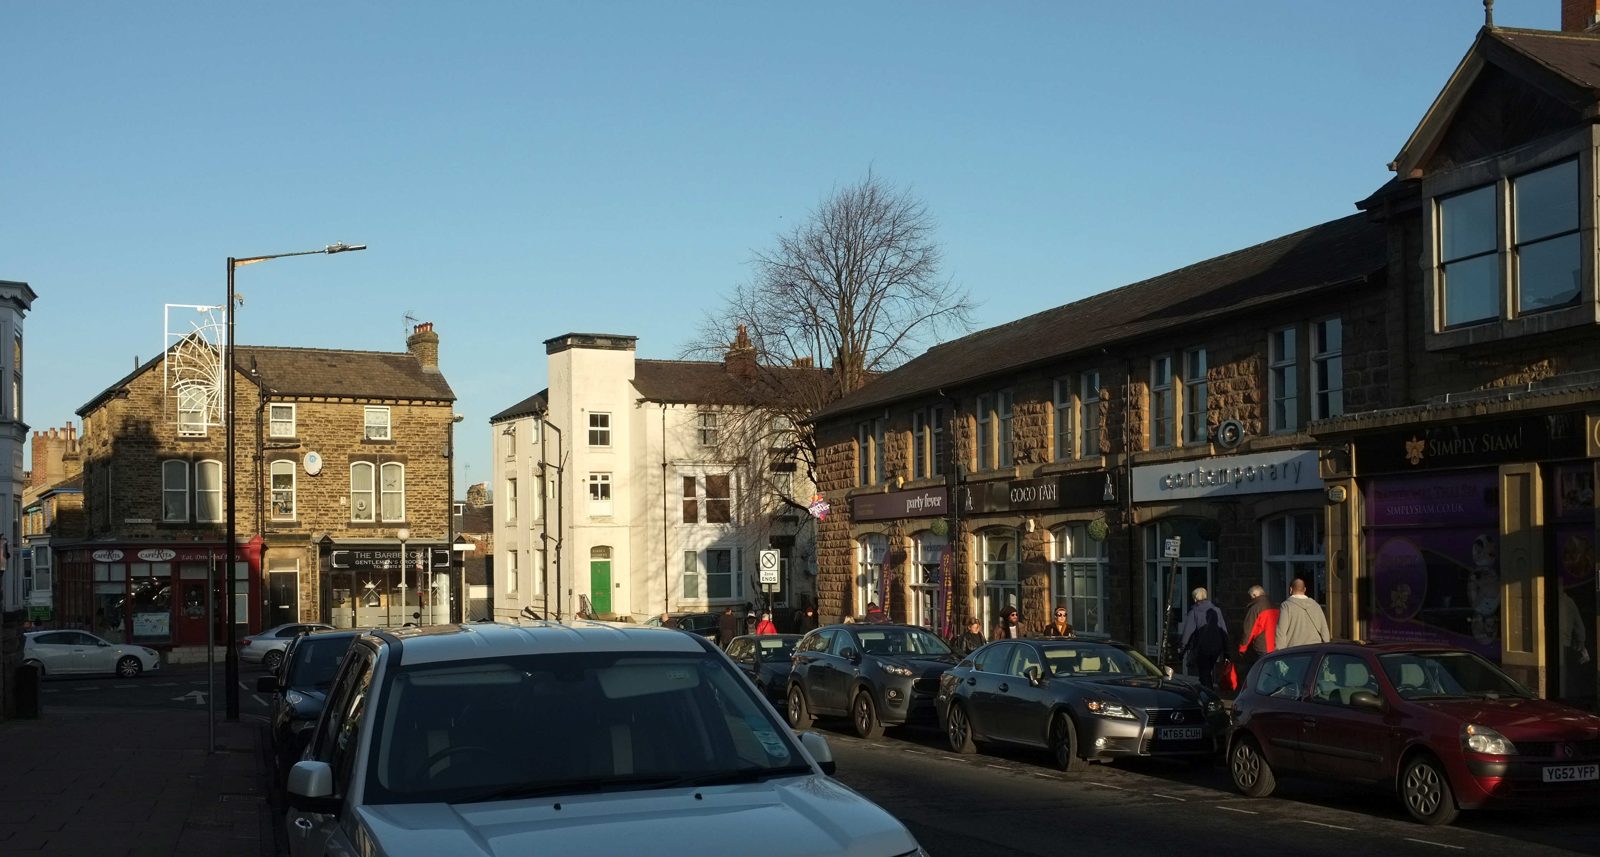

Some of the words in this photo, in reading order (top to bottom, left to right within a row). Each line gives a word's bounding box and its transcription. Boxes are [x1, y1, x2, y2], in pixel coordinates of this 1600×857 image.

[1429, 437, 1477, 457] SIMPLY
[1481, 433, 1519, 451] SIAM
[1164, 460, 1302, 489] contemporary
[906, 495, 923, 513] party
[924, 492, 942, 508] fever
[1010, 487, 1036, 503] COCO
[1038, 484, 1057, 501] TAN
[353, 551, 371, 559] THE
[374, 551, 408, 559] BARBER
[409, 551, 433, 559] CUB
[1163, 729, 1184, 739] MT65
[1185, 728, 1201, 738] CUH
[1547, 767, 1575, 780] YG52
[1577, 766, 1596, 778] YFP
